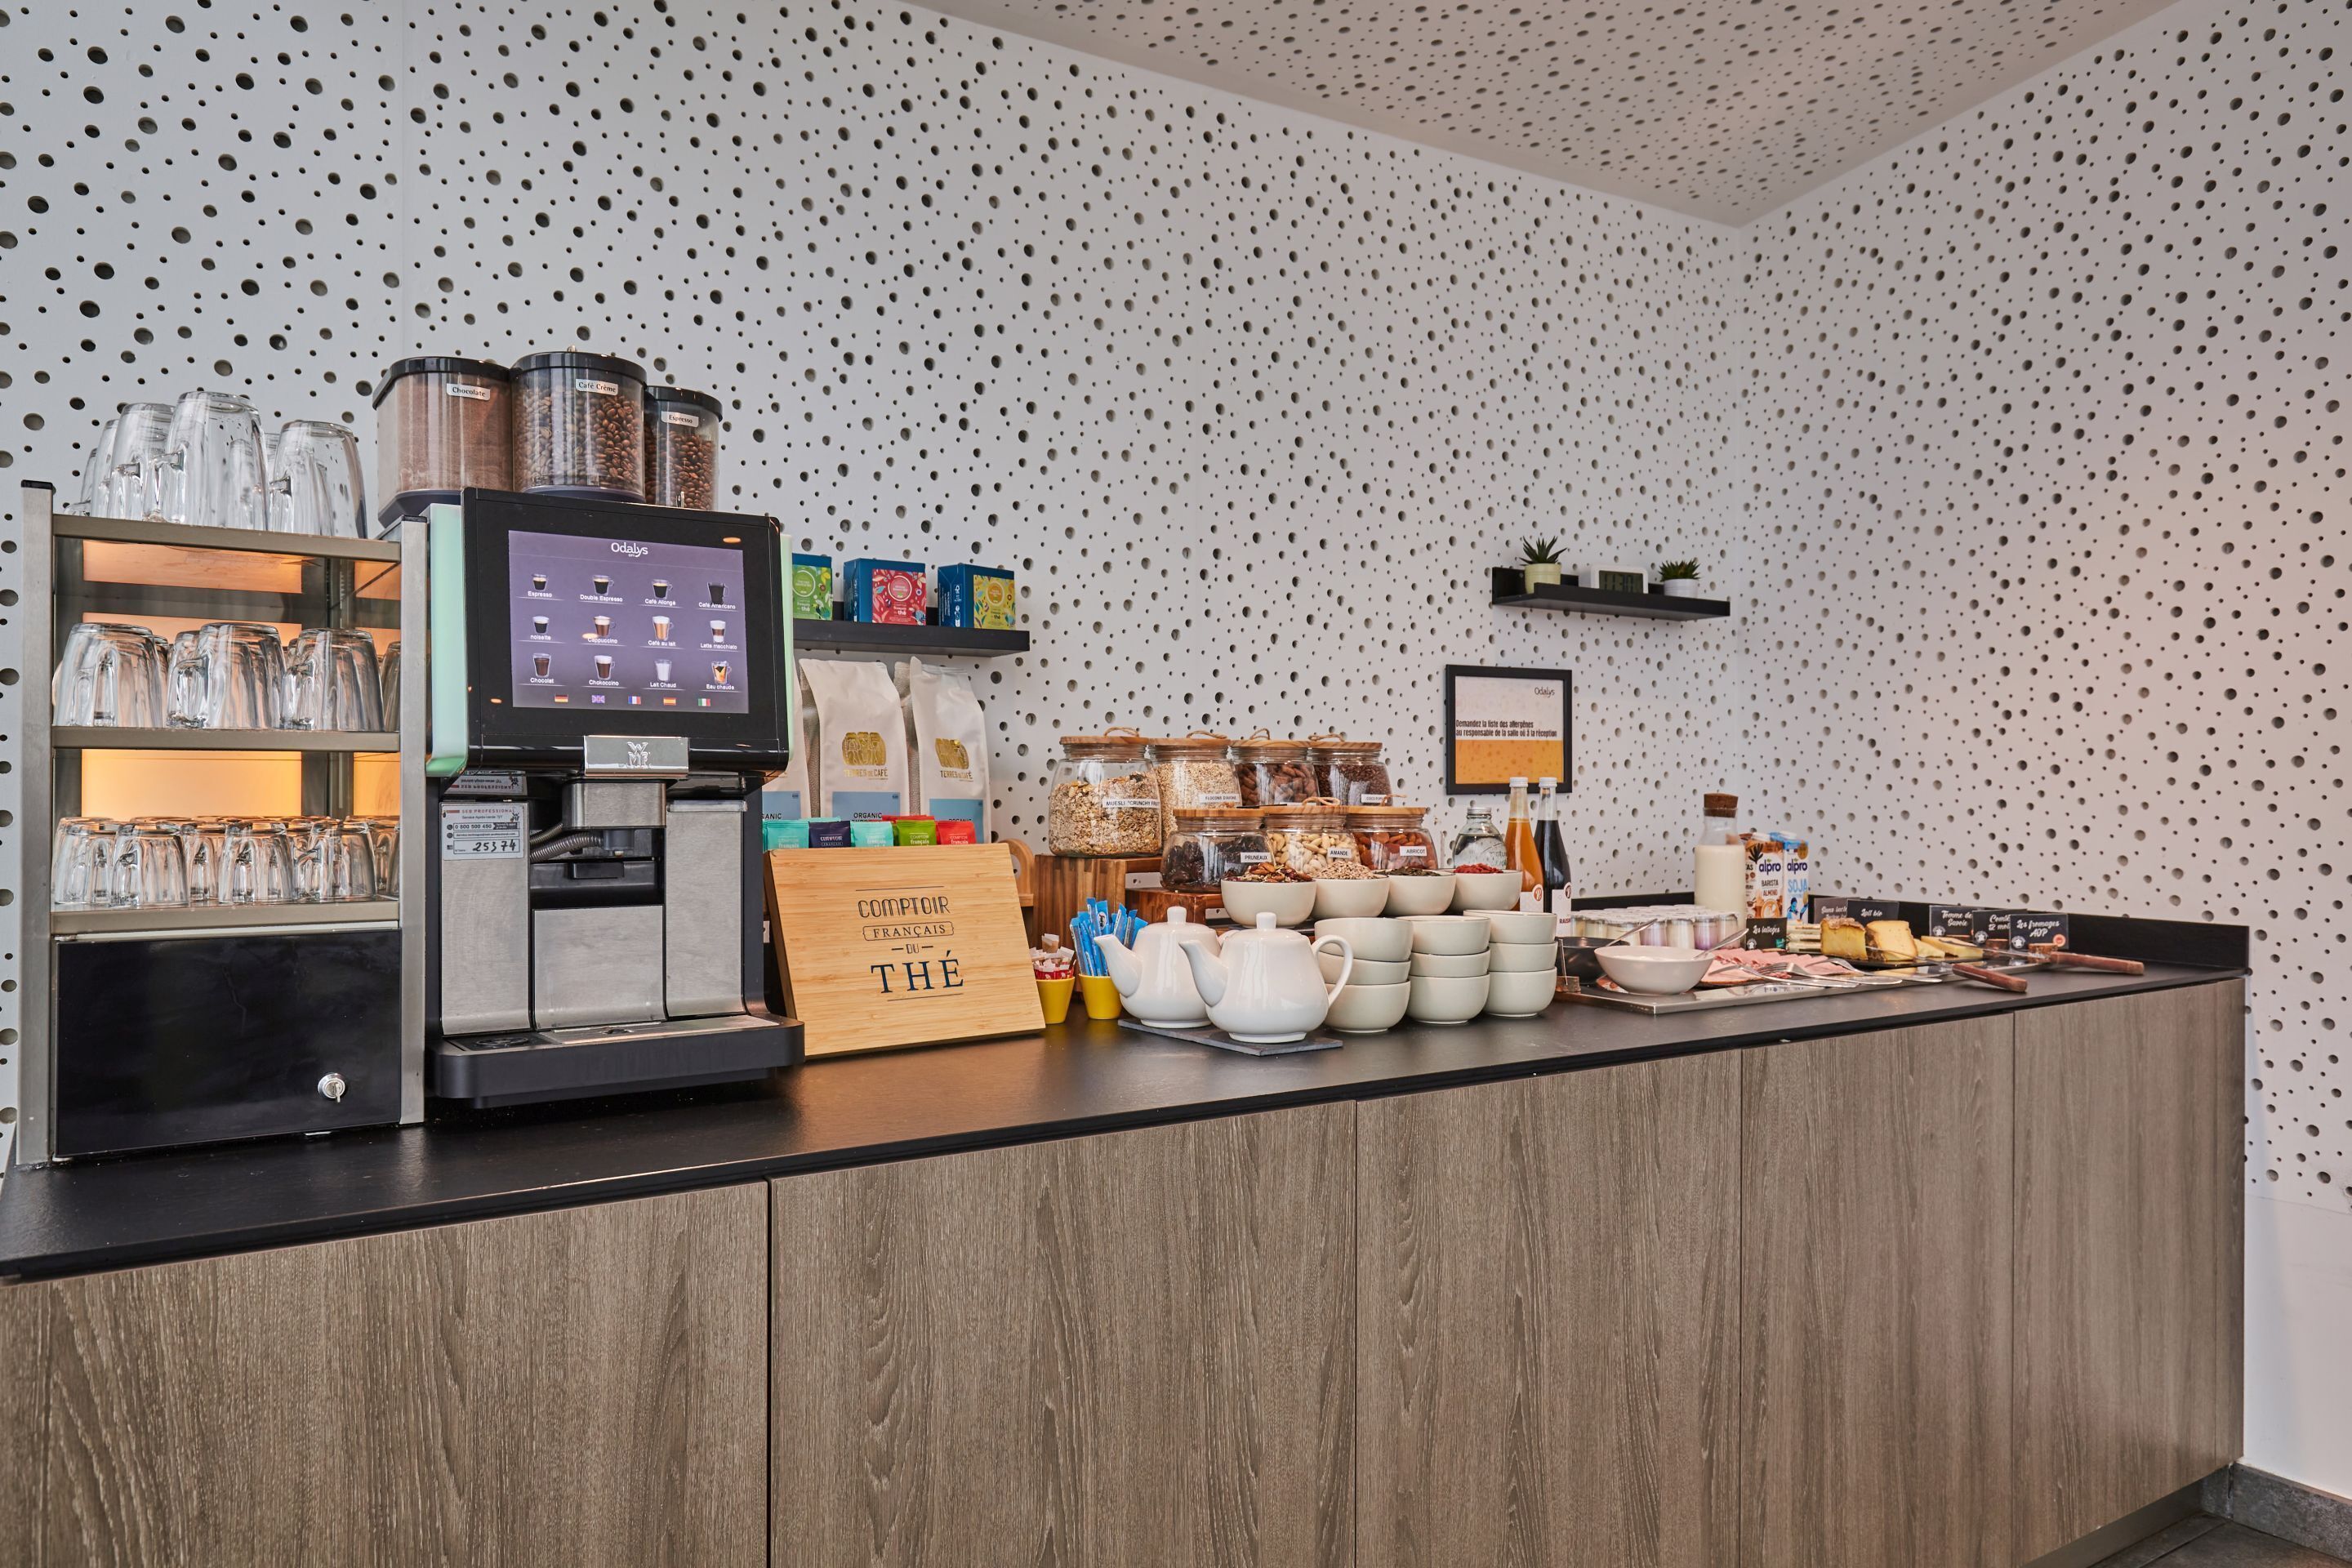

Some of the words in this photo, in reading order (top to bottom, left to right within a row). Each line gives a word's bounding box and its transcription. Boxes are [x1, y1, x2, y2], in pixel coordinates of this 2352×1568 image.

[452, 386, 486, 398] Chocolate
[578, 381, 595, 390] Café
[595, 382, 617, 393] Crème
[668, 415, 693, 424] Espresso
[611, 542, 648, 557] Odalys
[1534, 686, 1555, 698] Odalys
[1509, 720, 1533, 729] allergènes
[1536, 730, 1557, 738] réception
[874, 767, 888, 777] CAFÉ
[1759, 859, 1781, 875] alpro
[1787, 859, 1808, 874] alpro
[1788, 878, 1808, 893] SOJA
[858, 896, 951, 918] COMPTOIR
[1941, 910, 1962, 919] Tomme
[1947, 918, 1967, 927] Savoie
[2016, 919, 2027, 928] Les
[2028, 919, 2061, 930] fromages
[873, 924, 946, 938] FRANÇAIS
[1753, 925, 1761, 935] Les
[2029, 928, 2048, 938] AOP
[906, 943, 920, 954] DU
[871, 950, 964, 994] THÉ
